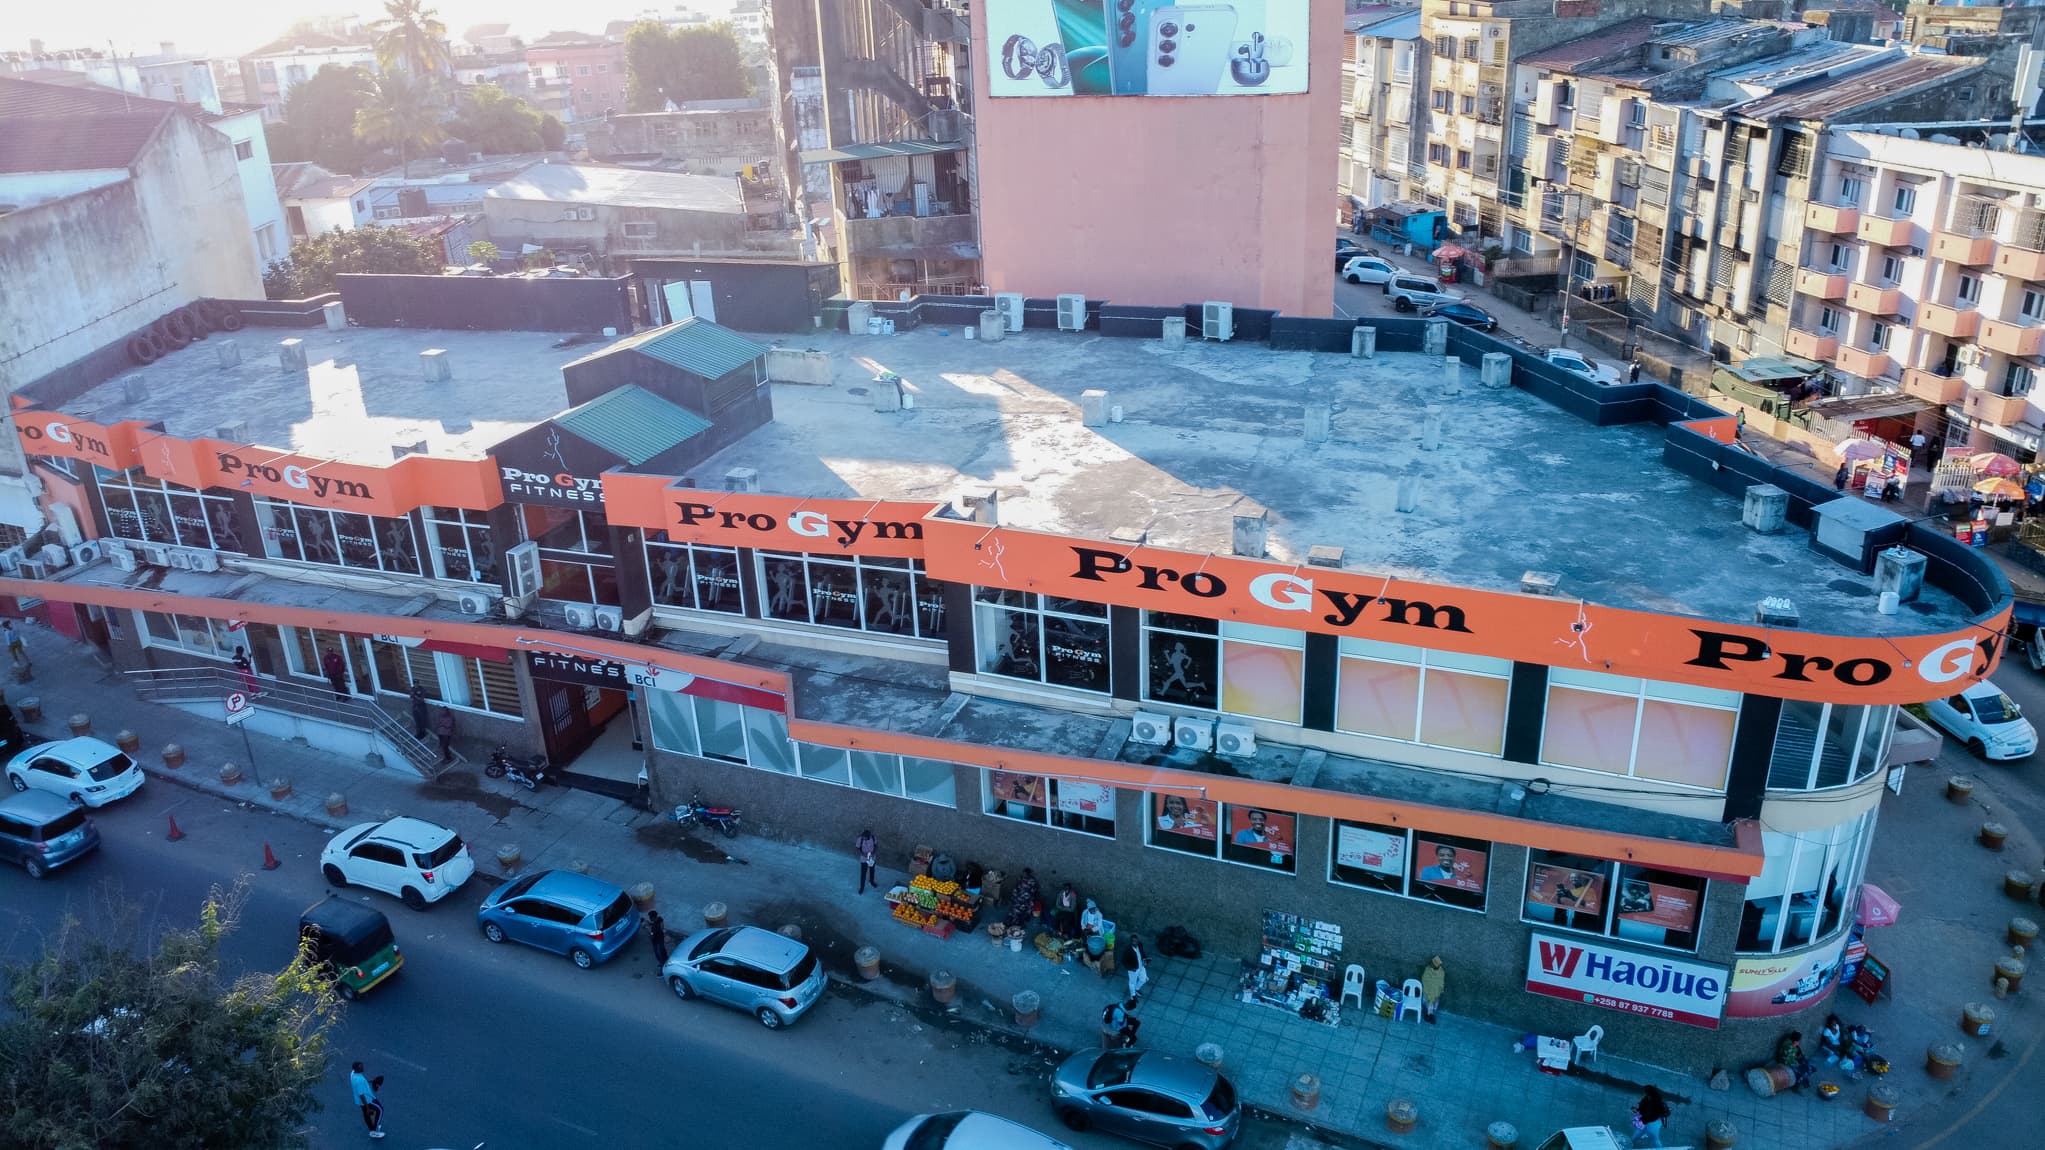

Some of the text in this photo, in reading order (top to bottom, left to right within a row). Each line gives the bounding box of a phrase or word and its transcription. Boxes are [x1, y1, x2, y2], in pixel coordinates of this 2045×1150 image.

[1070, 546, 1474, 634] Pro Gym
[634, 674, 656, 687] BCI
[1683, 628, 1892, 686] Pro
[1585, 952, 1719, 1001] Haojue
[1594, 997, 1616, 1008] +258
[1618, 1000, 1629, 1009] 87
[1632, 1003, 1649, 1013] 937
